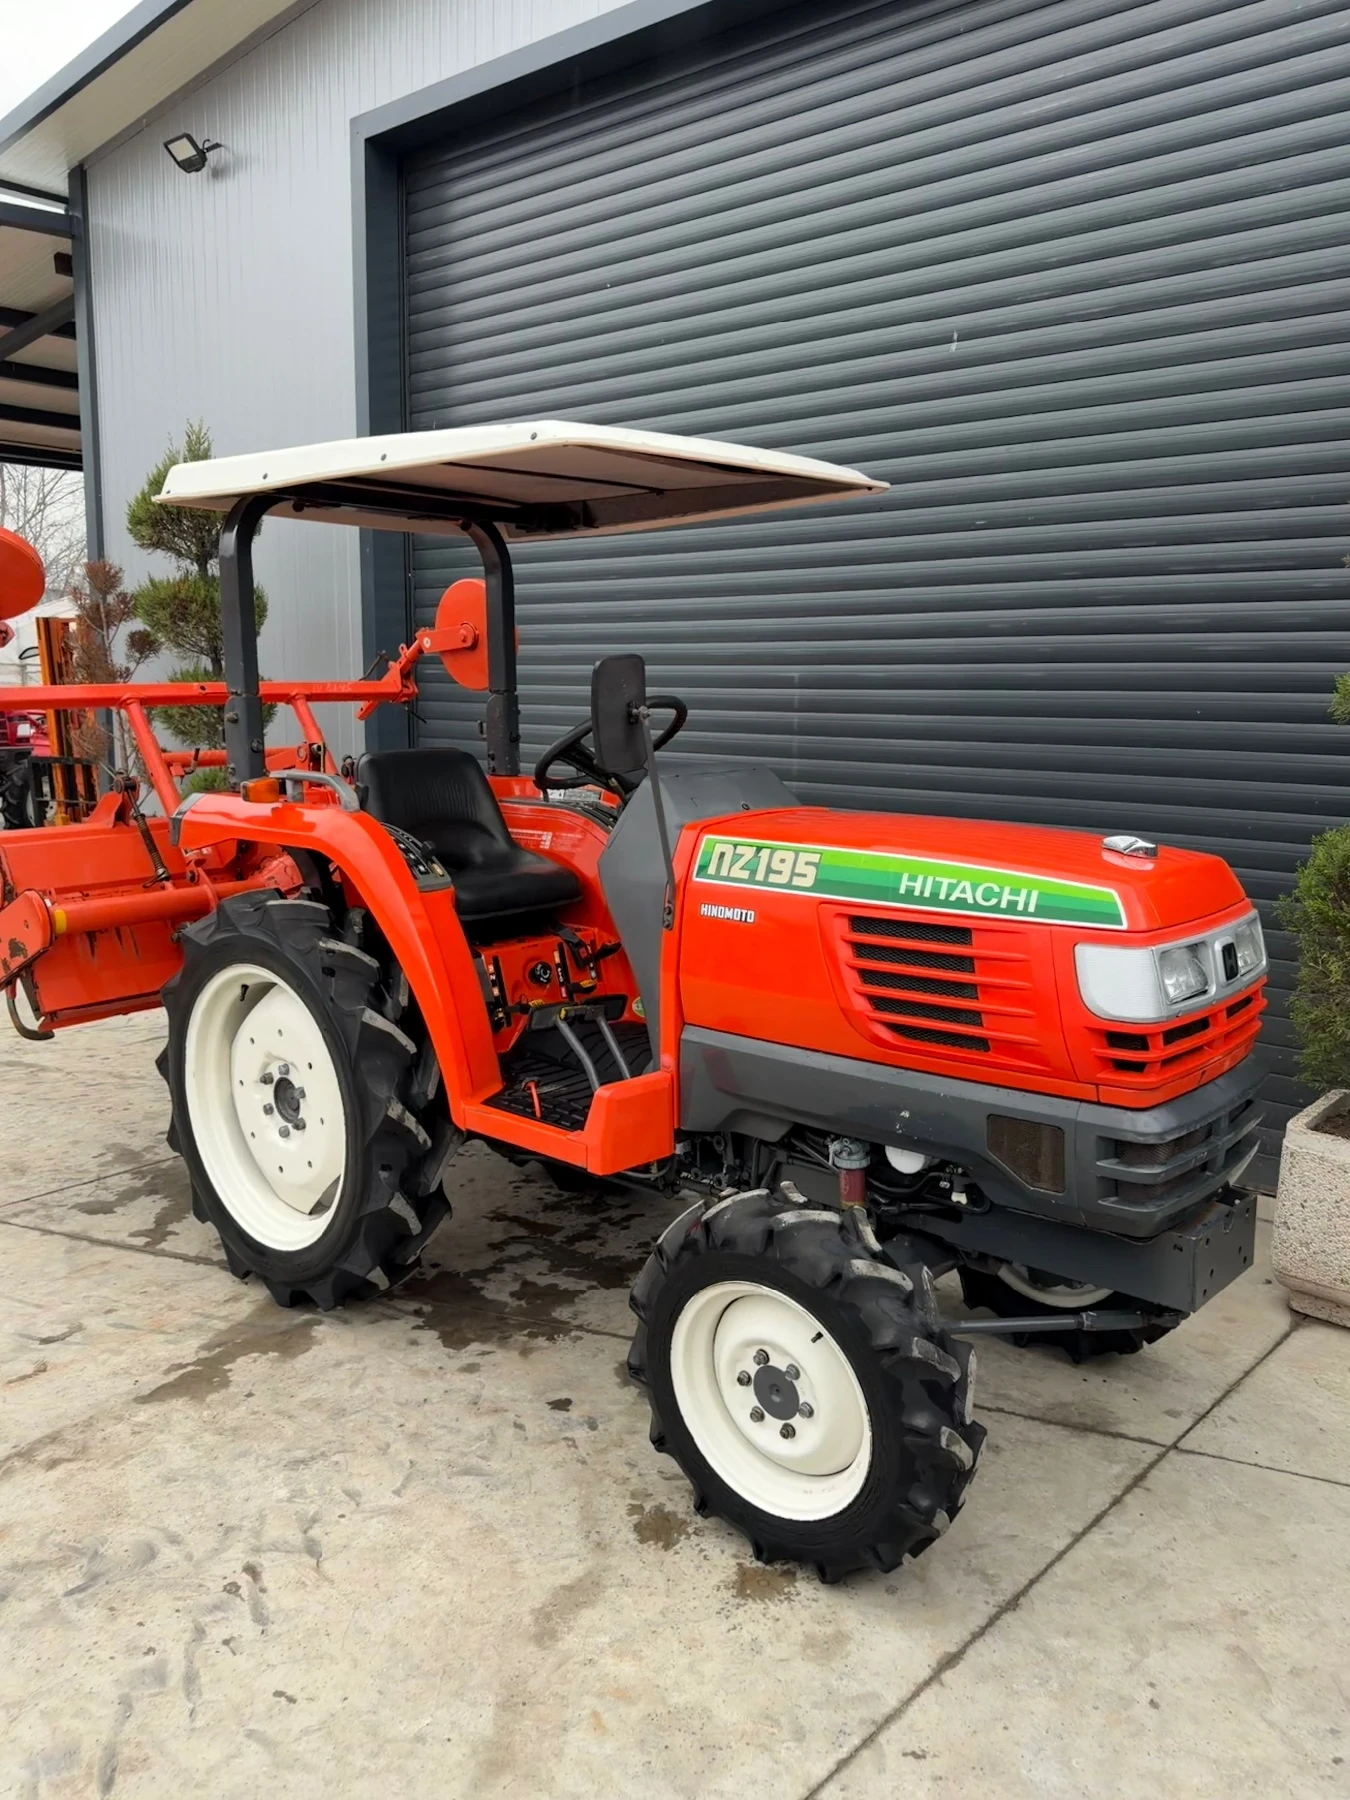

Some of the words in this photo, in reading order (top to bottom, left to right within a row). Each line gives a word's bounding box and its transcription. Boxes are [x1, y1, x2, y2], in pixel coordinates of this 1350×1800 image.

[707, 842, 821, 888] NZ195
[700, 903, 755, 923] HINOMOTO
[899, 872, 1039, 913] HITACHI
